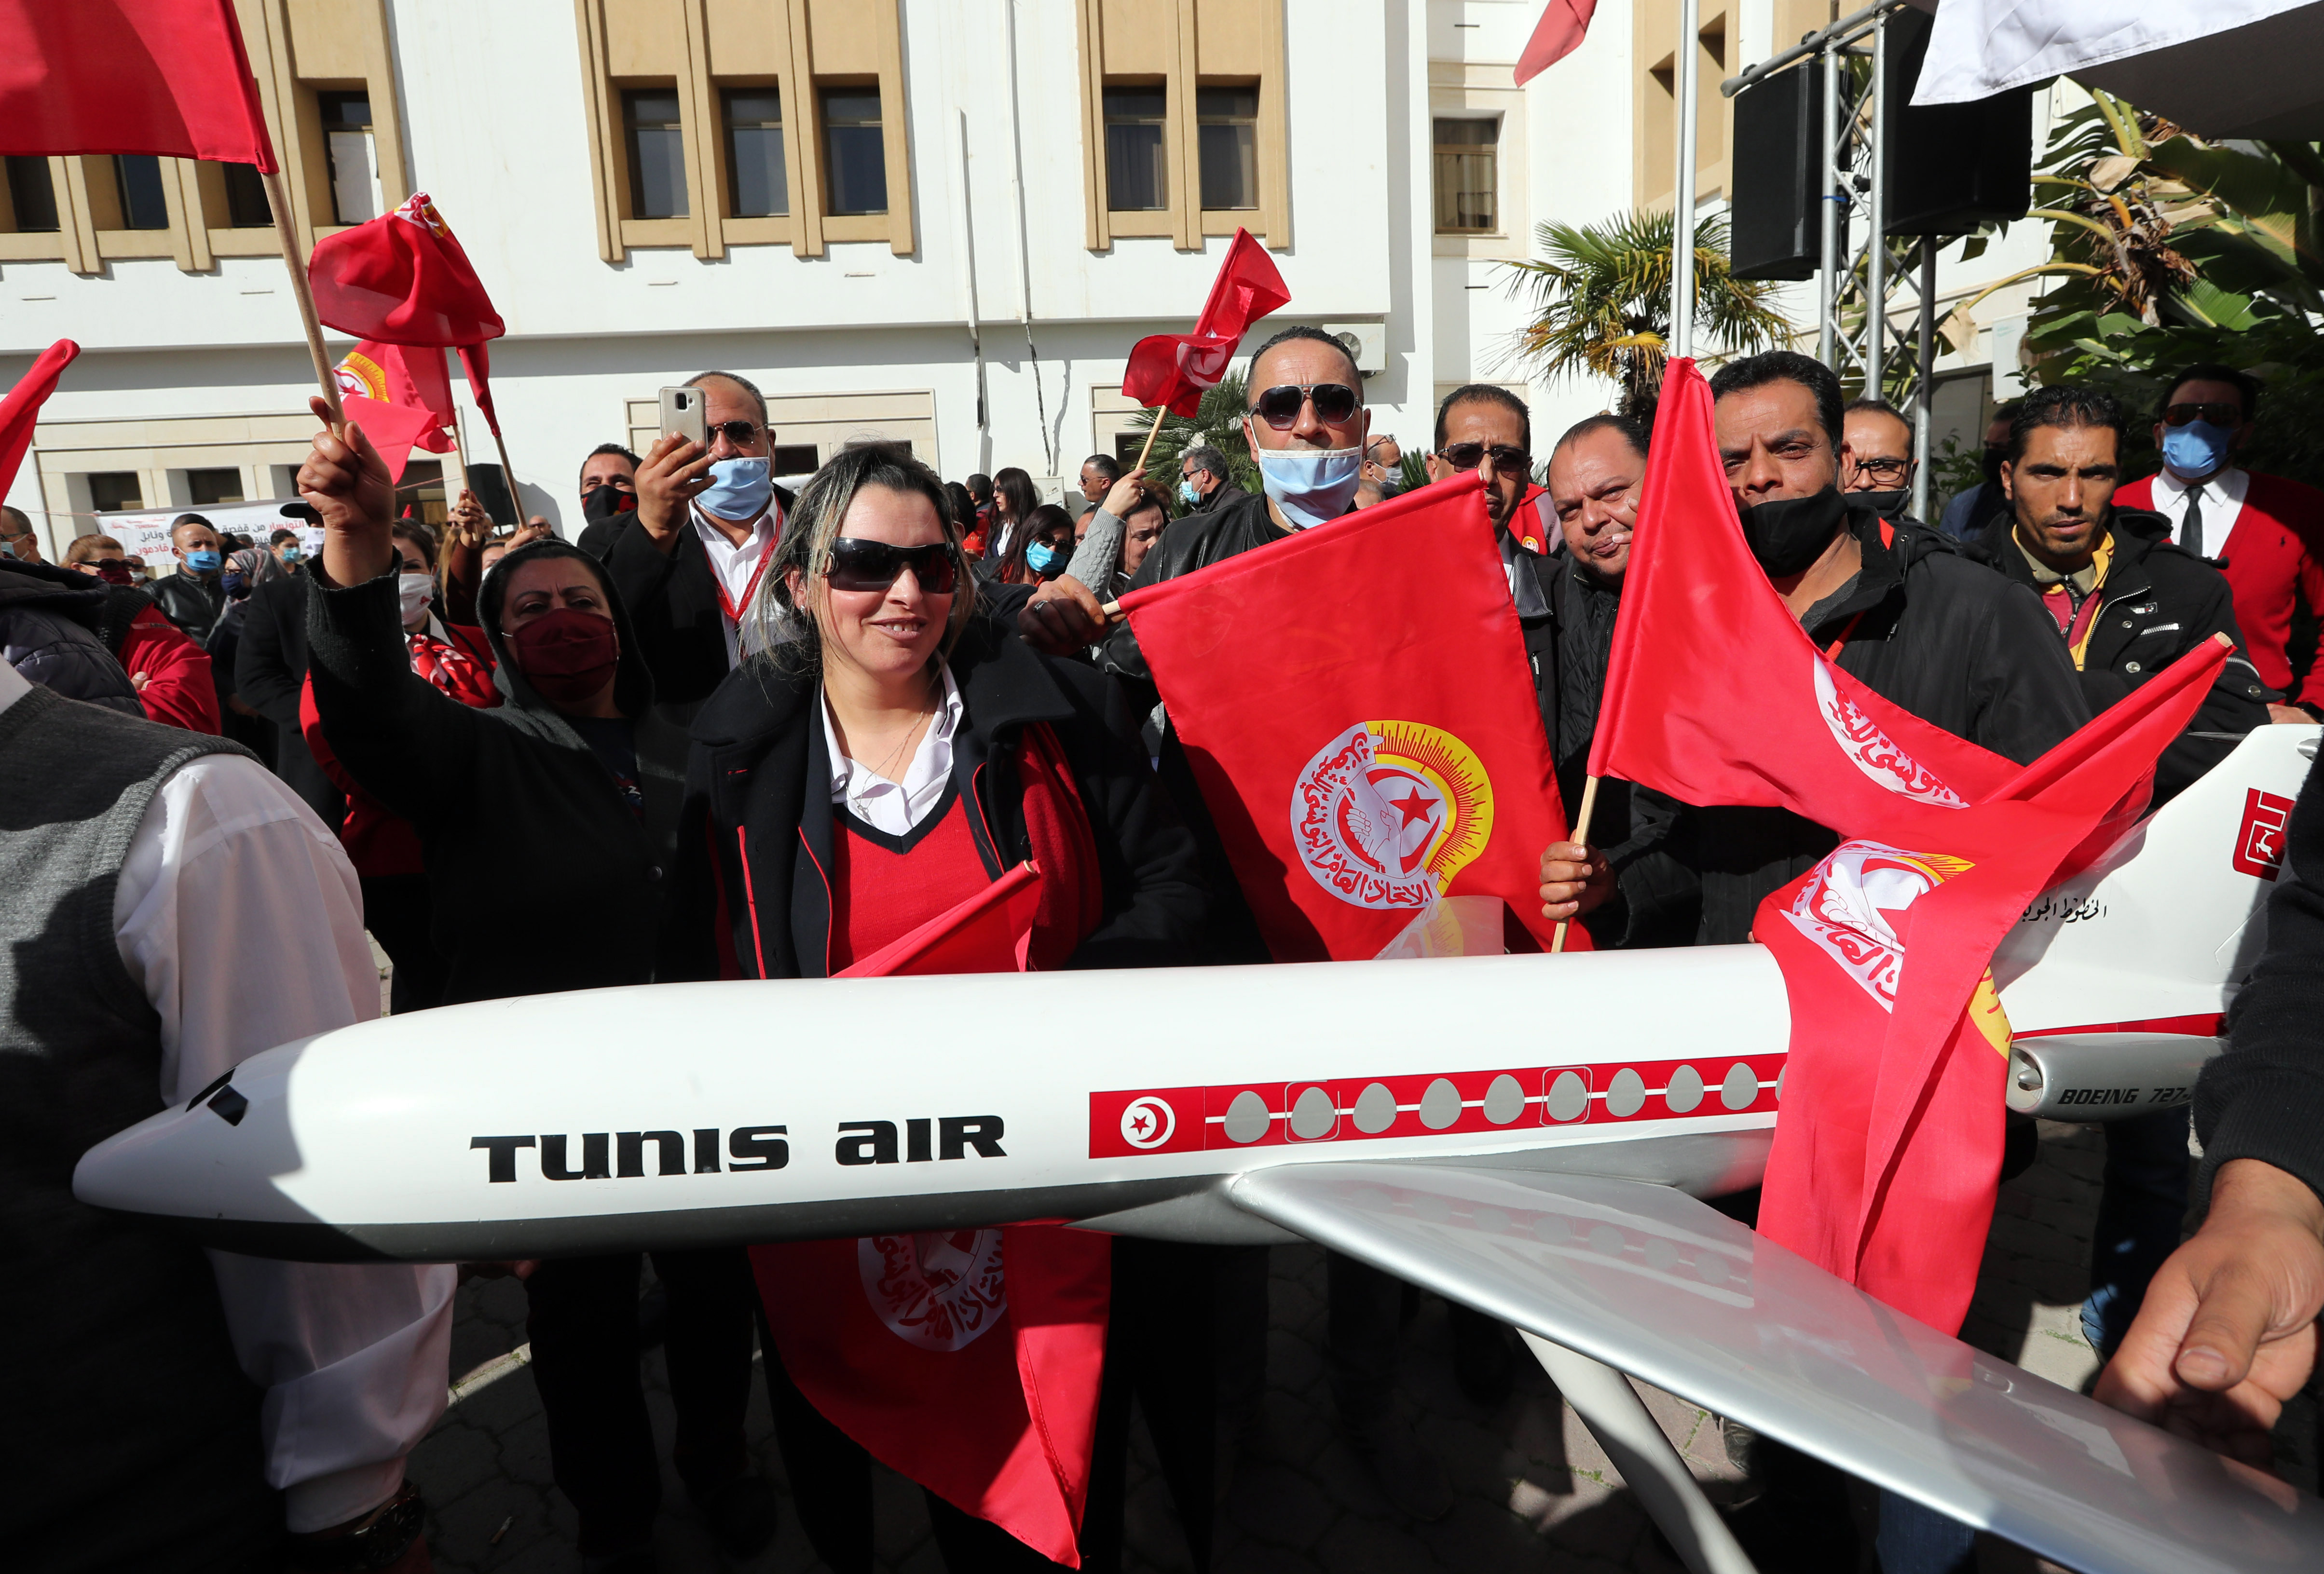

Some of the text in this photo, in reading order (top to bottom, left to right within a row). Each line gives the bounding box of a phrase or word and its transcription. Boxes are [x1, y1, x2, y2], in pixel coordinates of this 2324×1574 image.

[222, 524, 249, 533] قفصة
[253, 524, 265, 532] من
[140, 530, 164, 543] ونابل
[135, 543, 169, 556] قادمون
[2060, 897, 2107, 923] الخطوط
[2057, 1088, 2140, 1105] BOEING
